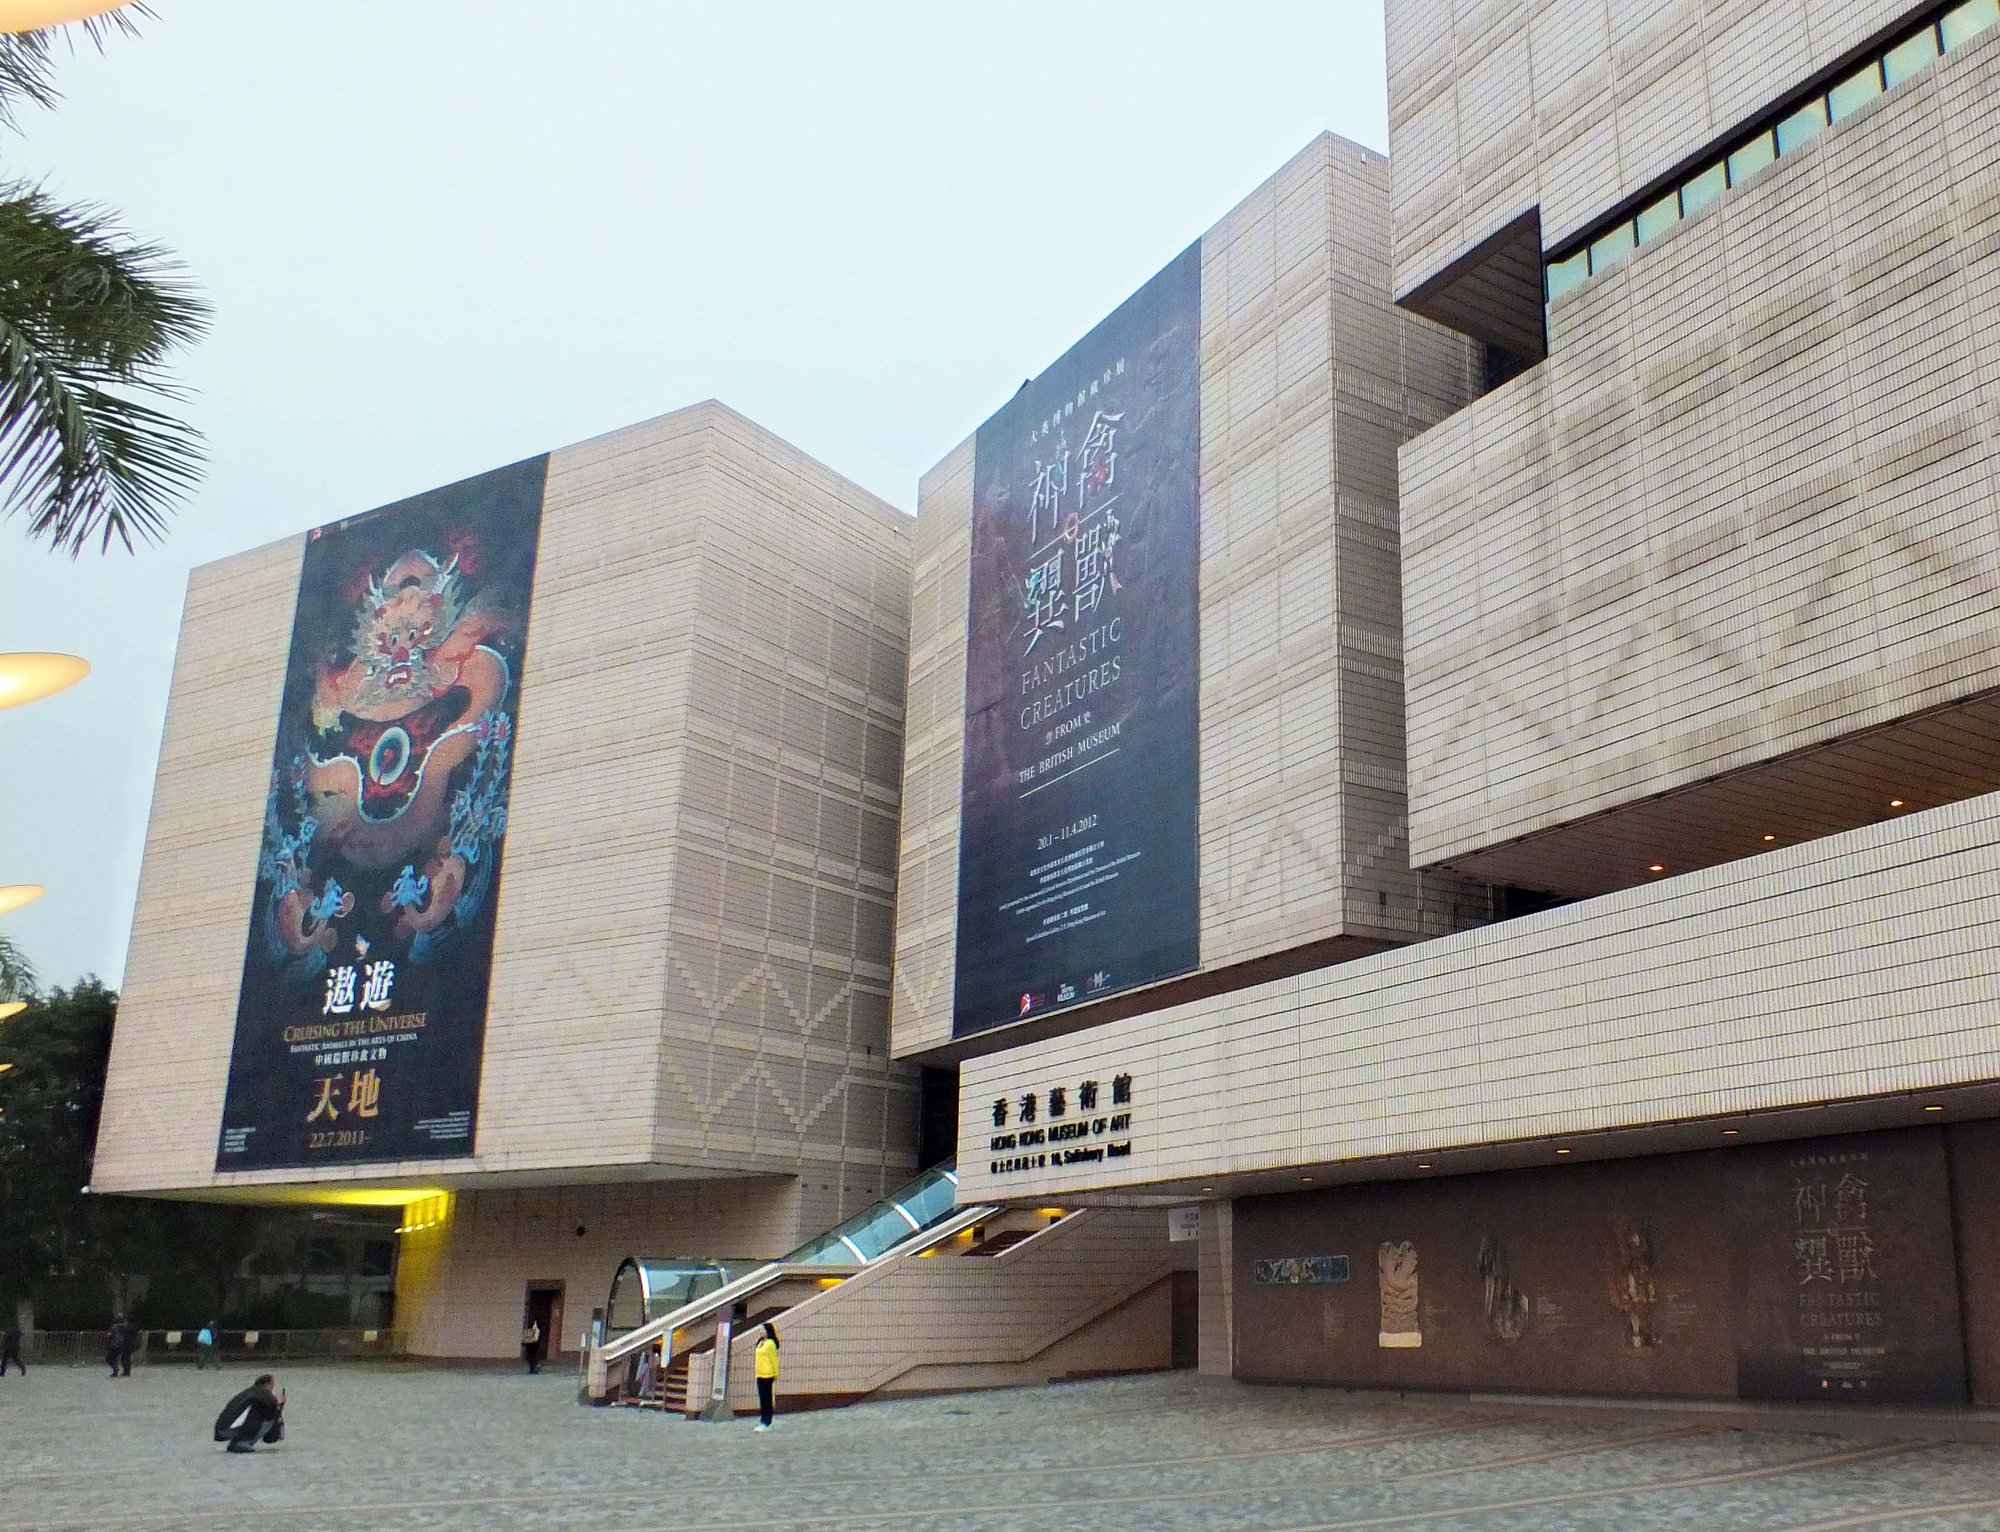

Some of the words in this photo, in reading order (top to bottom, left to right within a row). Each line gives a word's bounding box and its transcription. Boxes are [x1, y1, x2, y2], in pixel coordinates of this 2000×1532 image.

[1022, 617, 1121, 695] FANTASTIC
[1020, 655, 1122, 730] CREATURES
[1019, 765, 1036, 784] THE
[1039, 746, 1074, 774] BRITISH
[1077, 721, 1121, 754] MUSEUM
[1054, 714, 1082, 740] FROM
[1061, 814, 1098, 841] 11.4.2012
[323, 960, 396, 1015] 遨遊
[284, 1022, 340, 1042] CRUISING
[343, 1020, 367, 1036] THE
[370, 1012, 429, 1032] UNIVERSE
[306, 1068, 381, 1122] 天地
[991, 1133, 1016, 1151] HONG
[1019, 1129, 1045, 1147] KONG
[1048, 1121, 1089, 1142] MUSEUM
[1092, 1117, 1108, 1134] OF
[1110, 1113, 1132, 1131] ART
